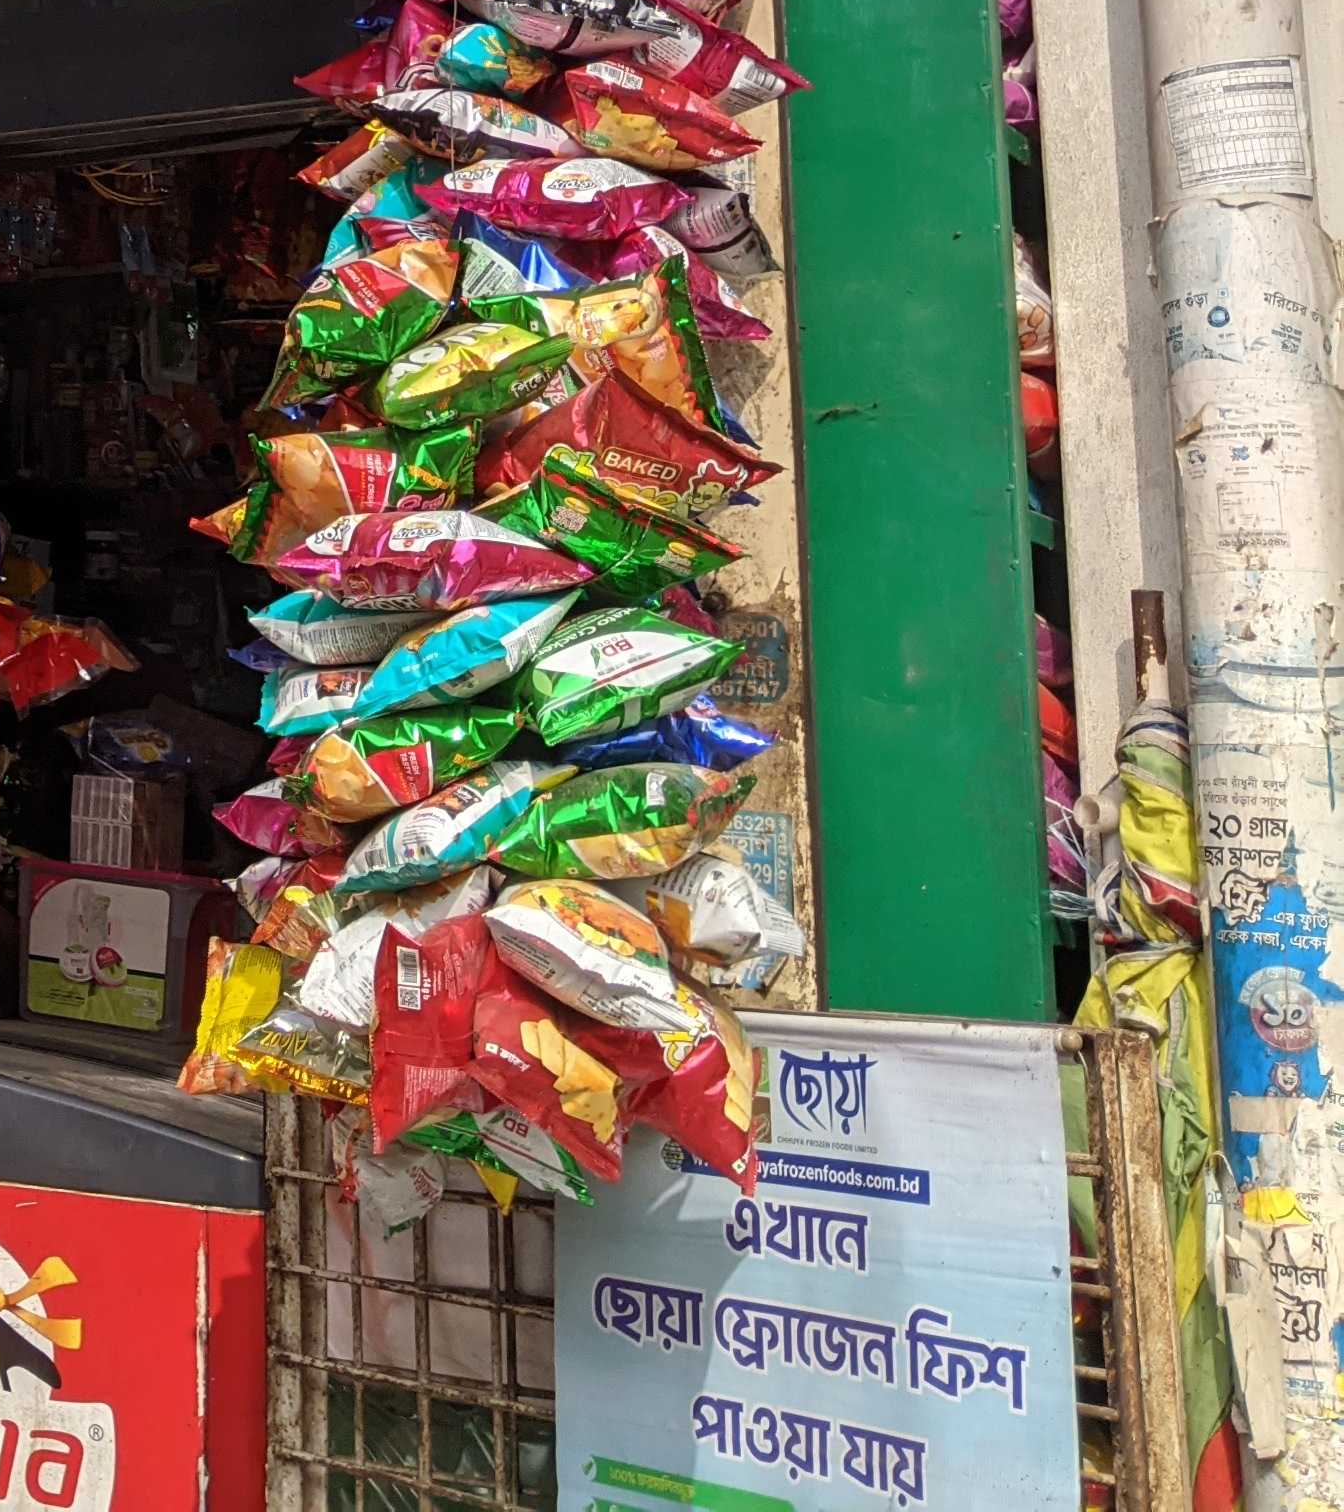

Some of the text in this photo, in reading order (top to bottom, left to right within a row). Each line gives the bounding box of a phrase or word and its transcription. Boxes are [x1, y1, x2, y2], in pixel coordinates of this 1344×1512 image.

[1185, 289, 1209, 308] গুঁড়া
[1264, 292, 1308, 316] মরিচের
[604, 451, 678, 482] BAKED
[602, 636, 632, 657] BD
[1262, 778, 1287, 793] হলুদ
[1208, 811, 1287, 840] ২০ গ্রাম
[1262, 994, 1308, 1027] ১০
[258, 1030, 309, 1056] Alooz
[503, 1118, 529, 1139] BD
[726, 1198, 868, 1271] এখানে
[594, 1277, 1026, 1411] ছোয়া ফ্রোজেন ফিশ
[693, 1394, 925, 1506] পাওয়া যায়
